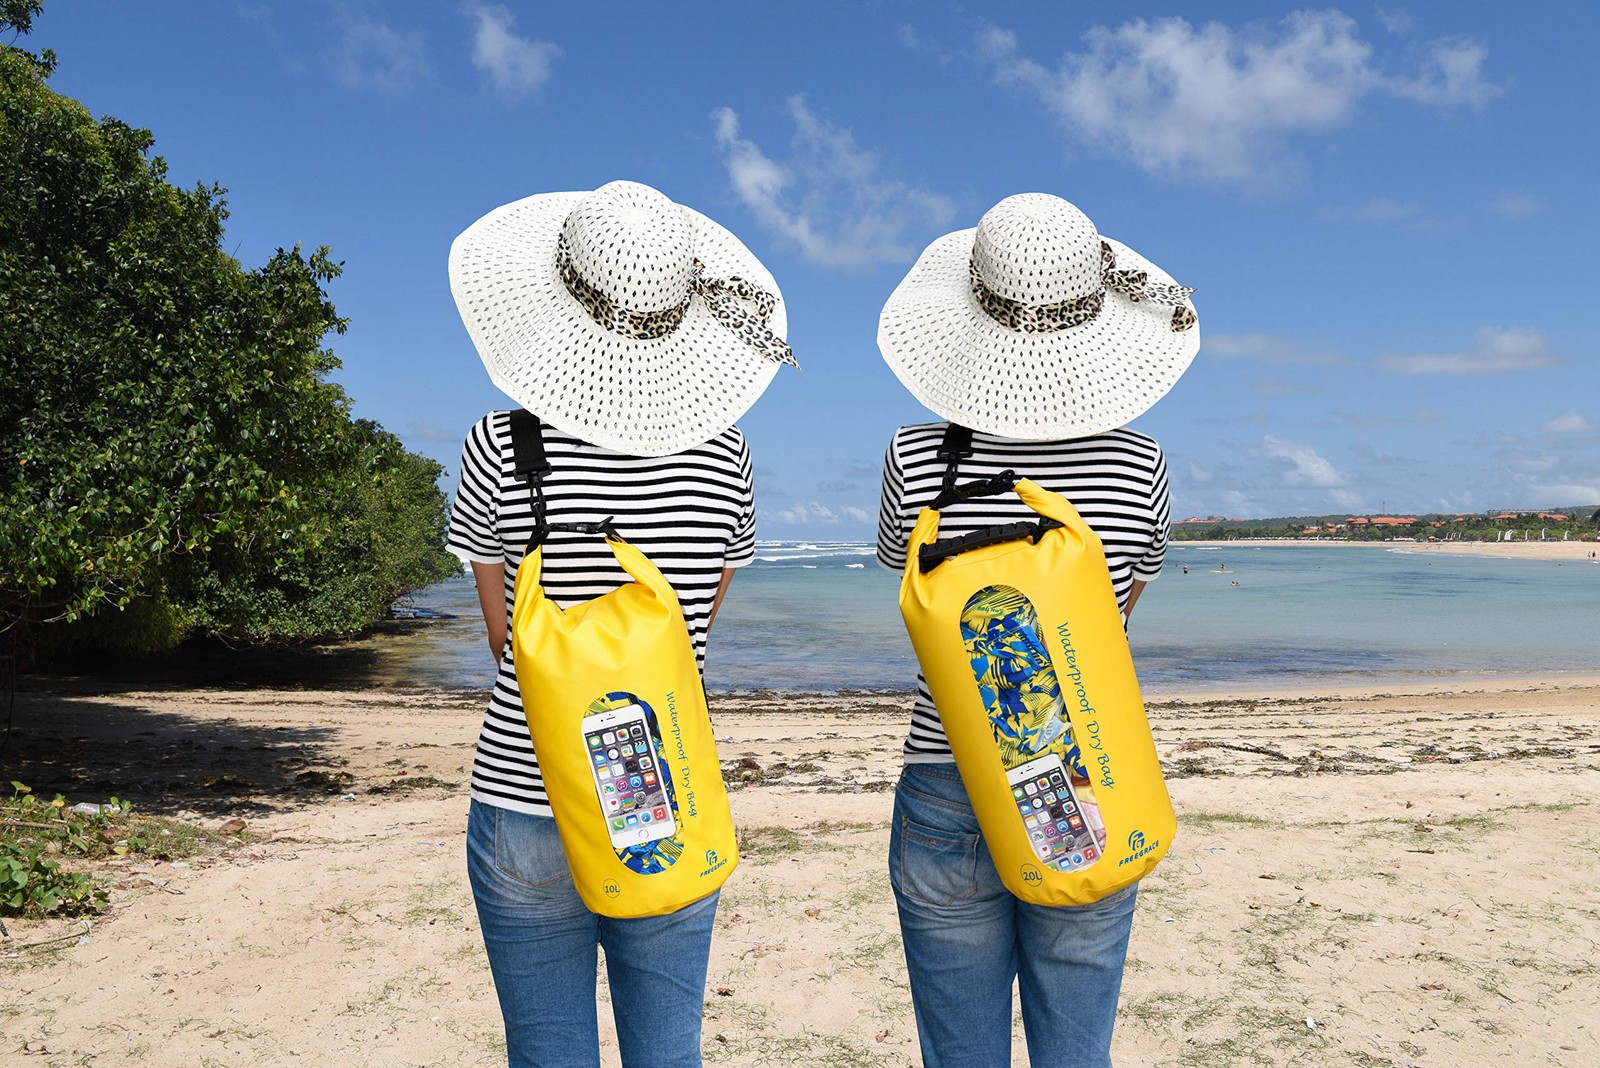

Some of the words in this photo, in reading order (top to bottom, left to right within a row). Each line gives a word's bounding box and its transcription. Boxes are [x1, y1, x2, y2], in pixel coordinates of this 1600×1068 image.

[1057, 622, 1096, 714] Waterproof
[1087, 721, 1103, 750] Dry
[1097, 754, 1114, 788] Bag
[666, 692, 688, 761] Waterproof
[682, 766, 691, 789] Dry
[687, 791, 698, 817] Bag
[1118, 840, 1159, 867] FREEGRACE
[605, 884, 620, 895] 10L
[1023, 870, 1042, 883] 20L
